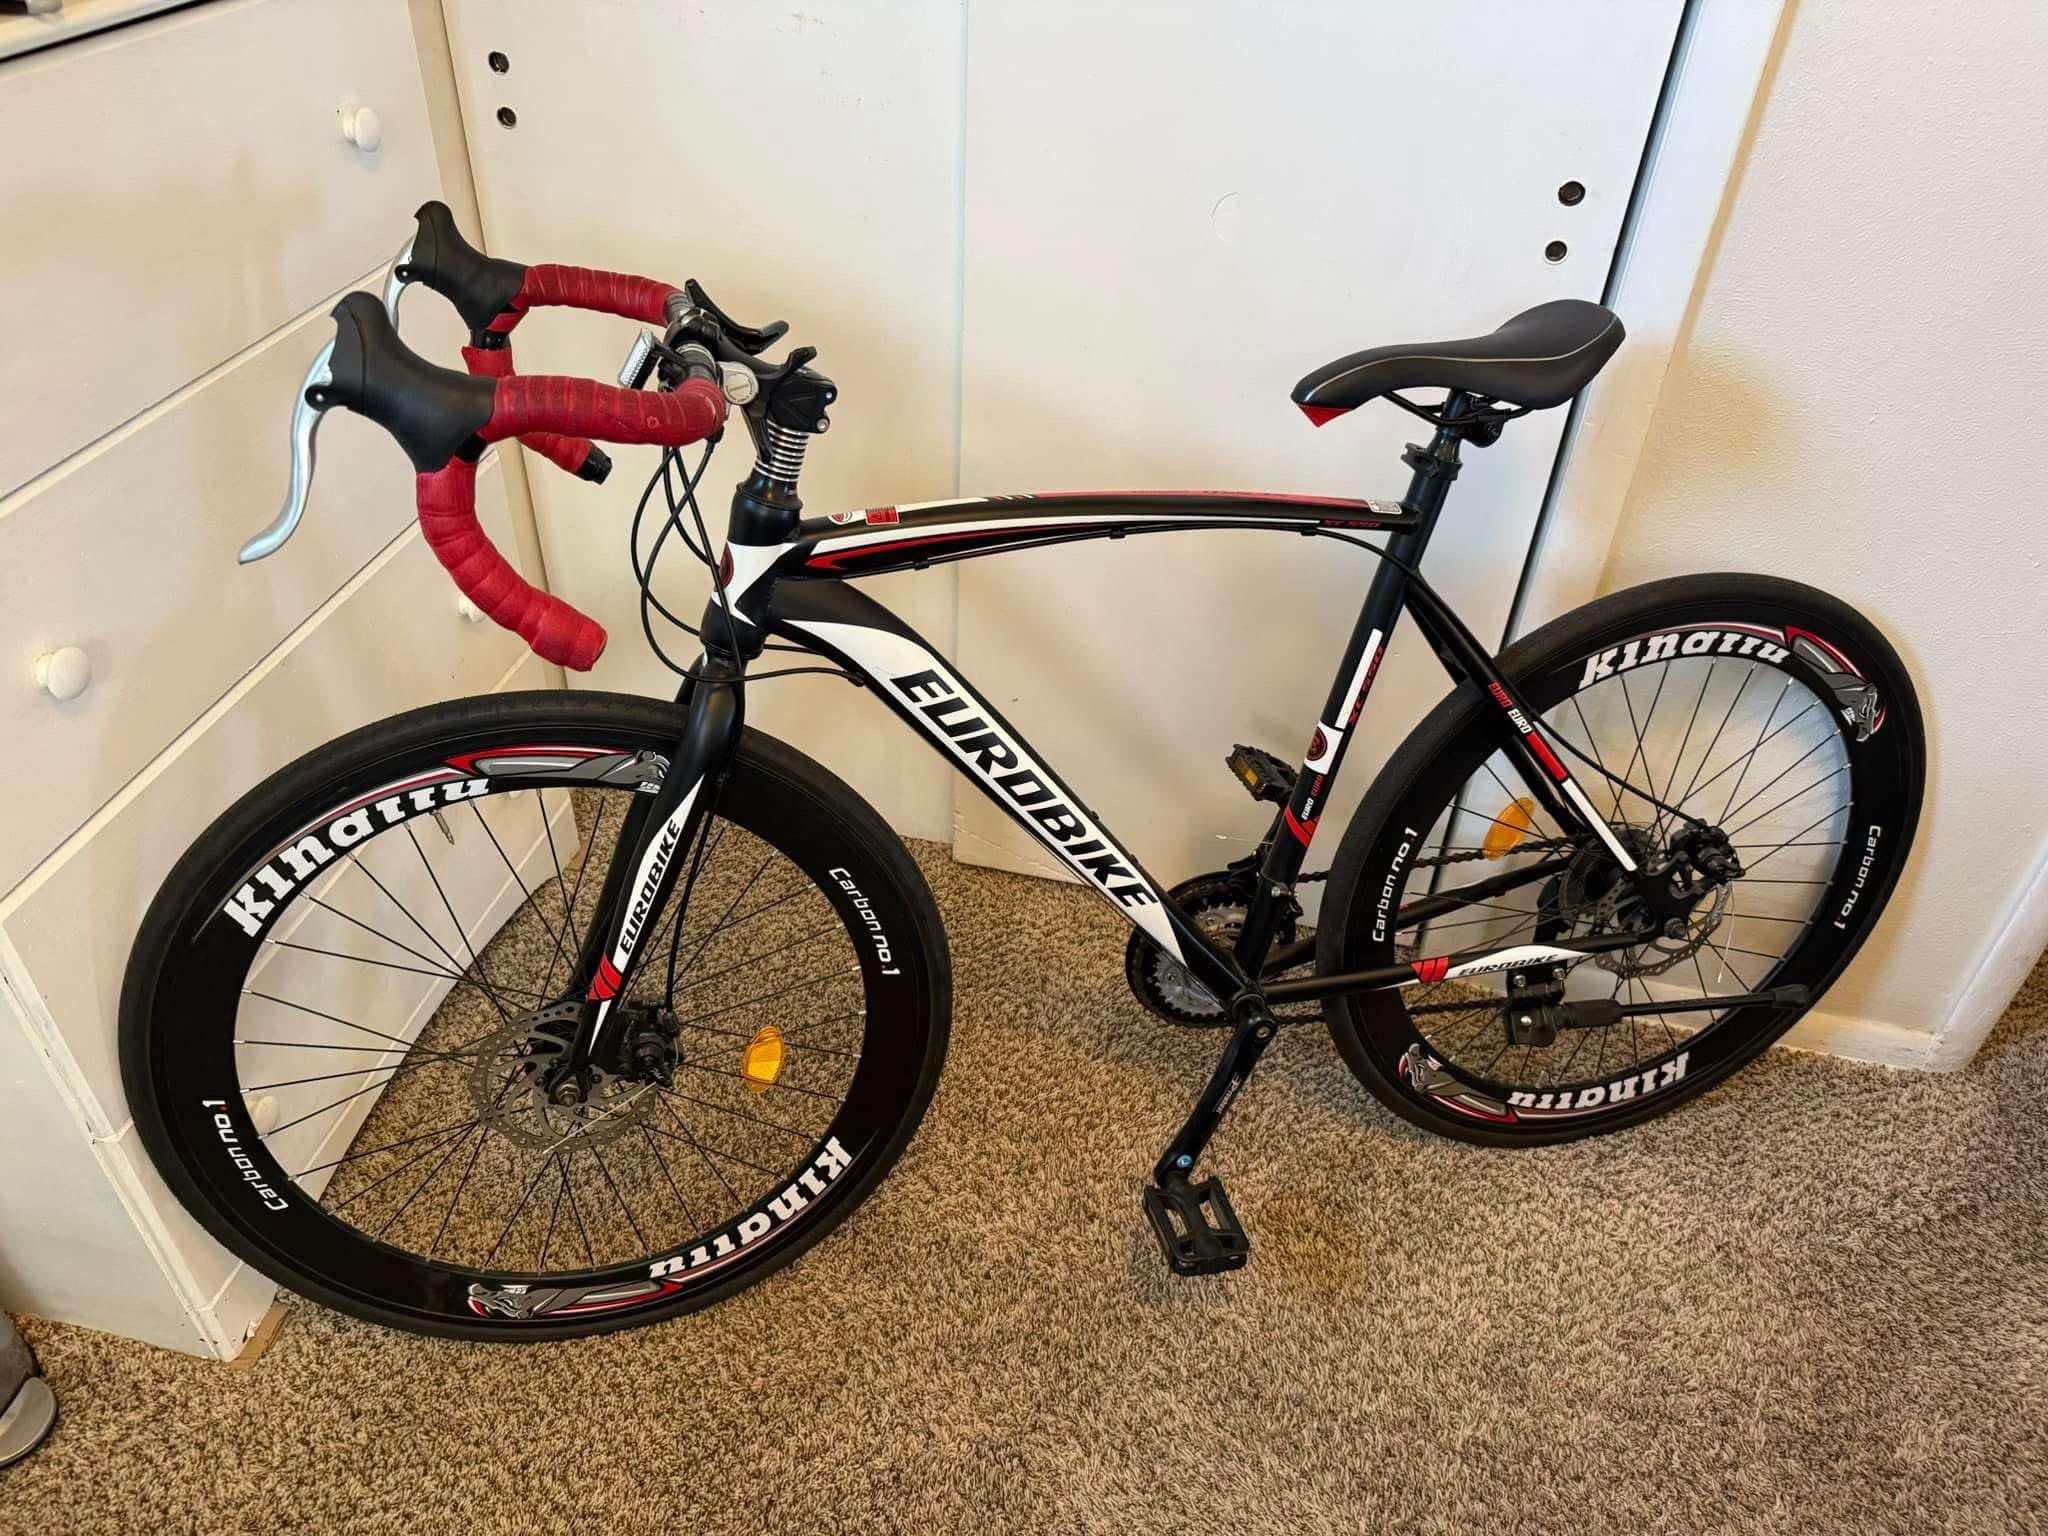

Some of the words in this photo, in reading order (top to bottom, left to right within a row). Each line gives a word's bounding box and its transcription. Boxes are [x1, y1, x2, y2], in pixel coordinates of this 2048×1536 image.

[1507, 708, 1533, 733] EURO
[890, 669, 1158, 908] EUROBIKE
[1301, 797, 1314, 820] EURO
[620, 819, 680, 955] EUROBIKE
[1855, 825, 1881, 889] Carbon
[829, 867, 881, 931] Carbon
[1372, 874, 1396, 942] Carbon
[1459, 953, 1558, 976] EUROBIKE
[228, 1147, 288, 1210] Carbon
